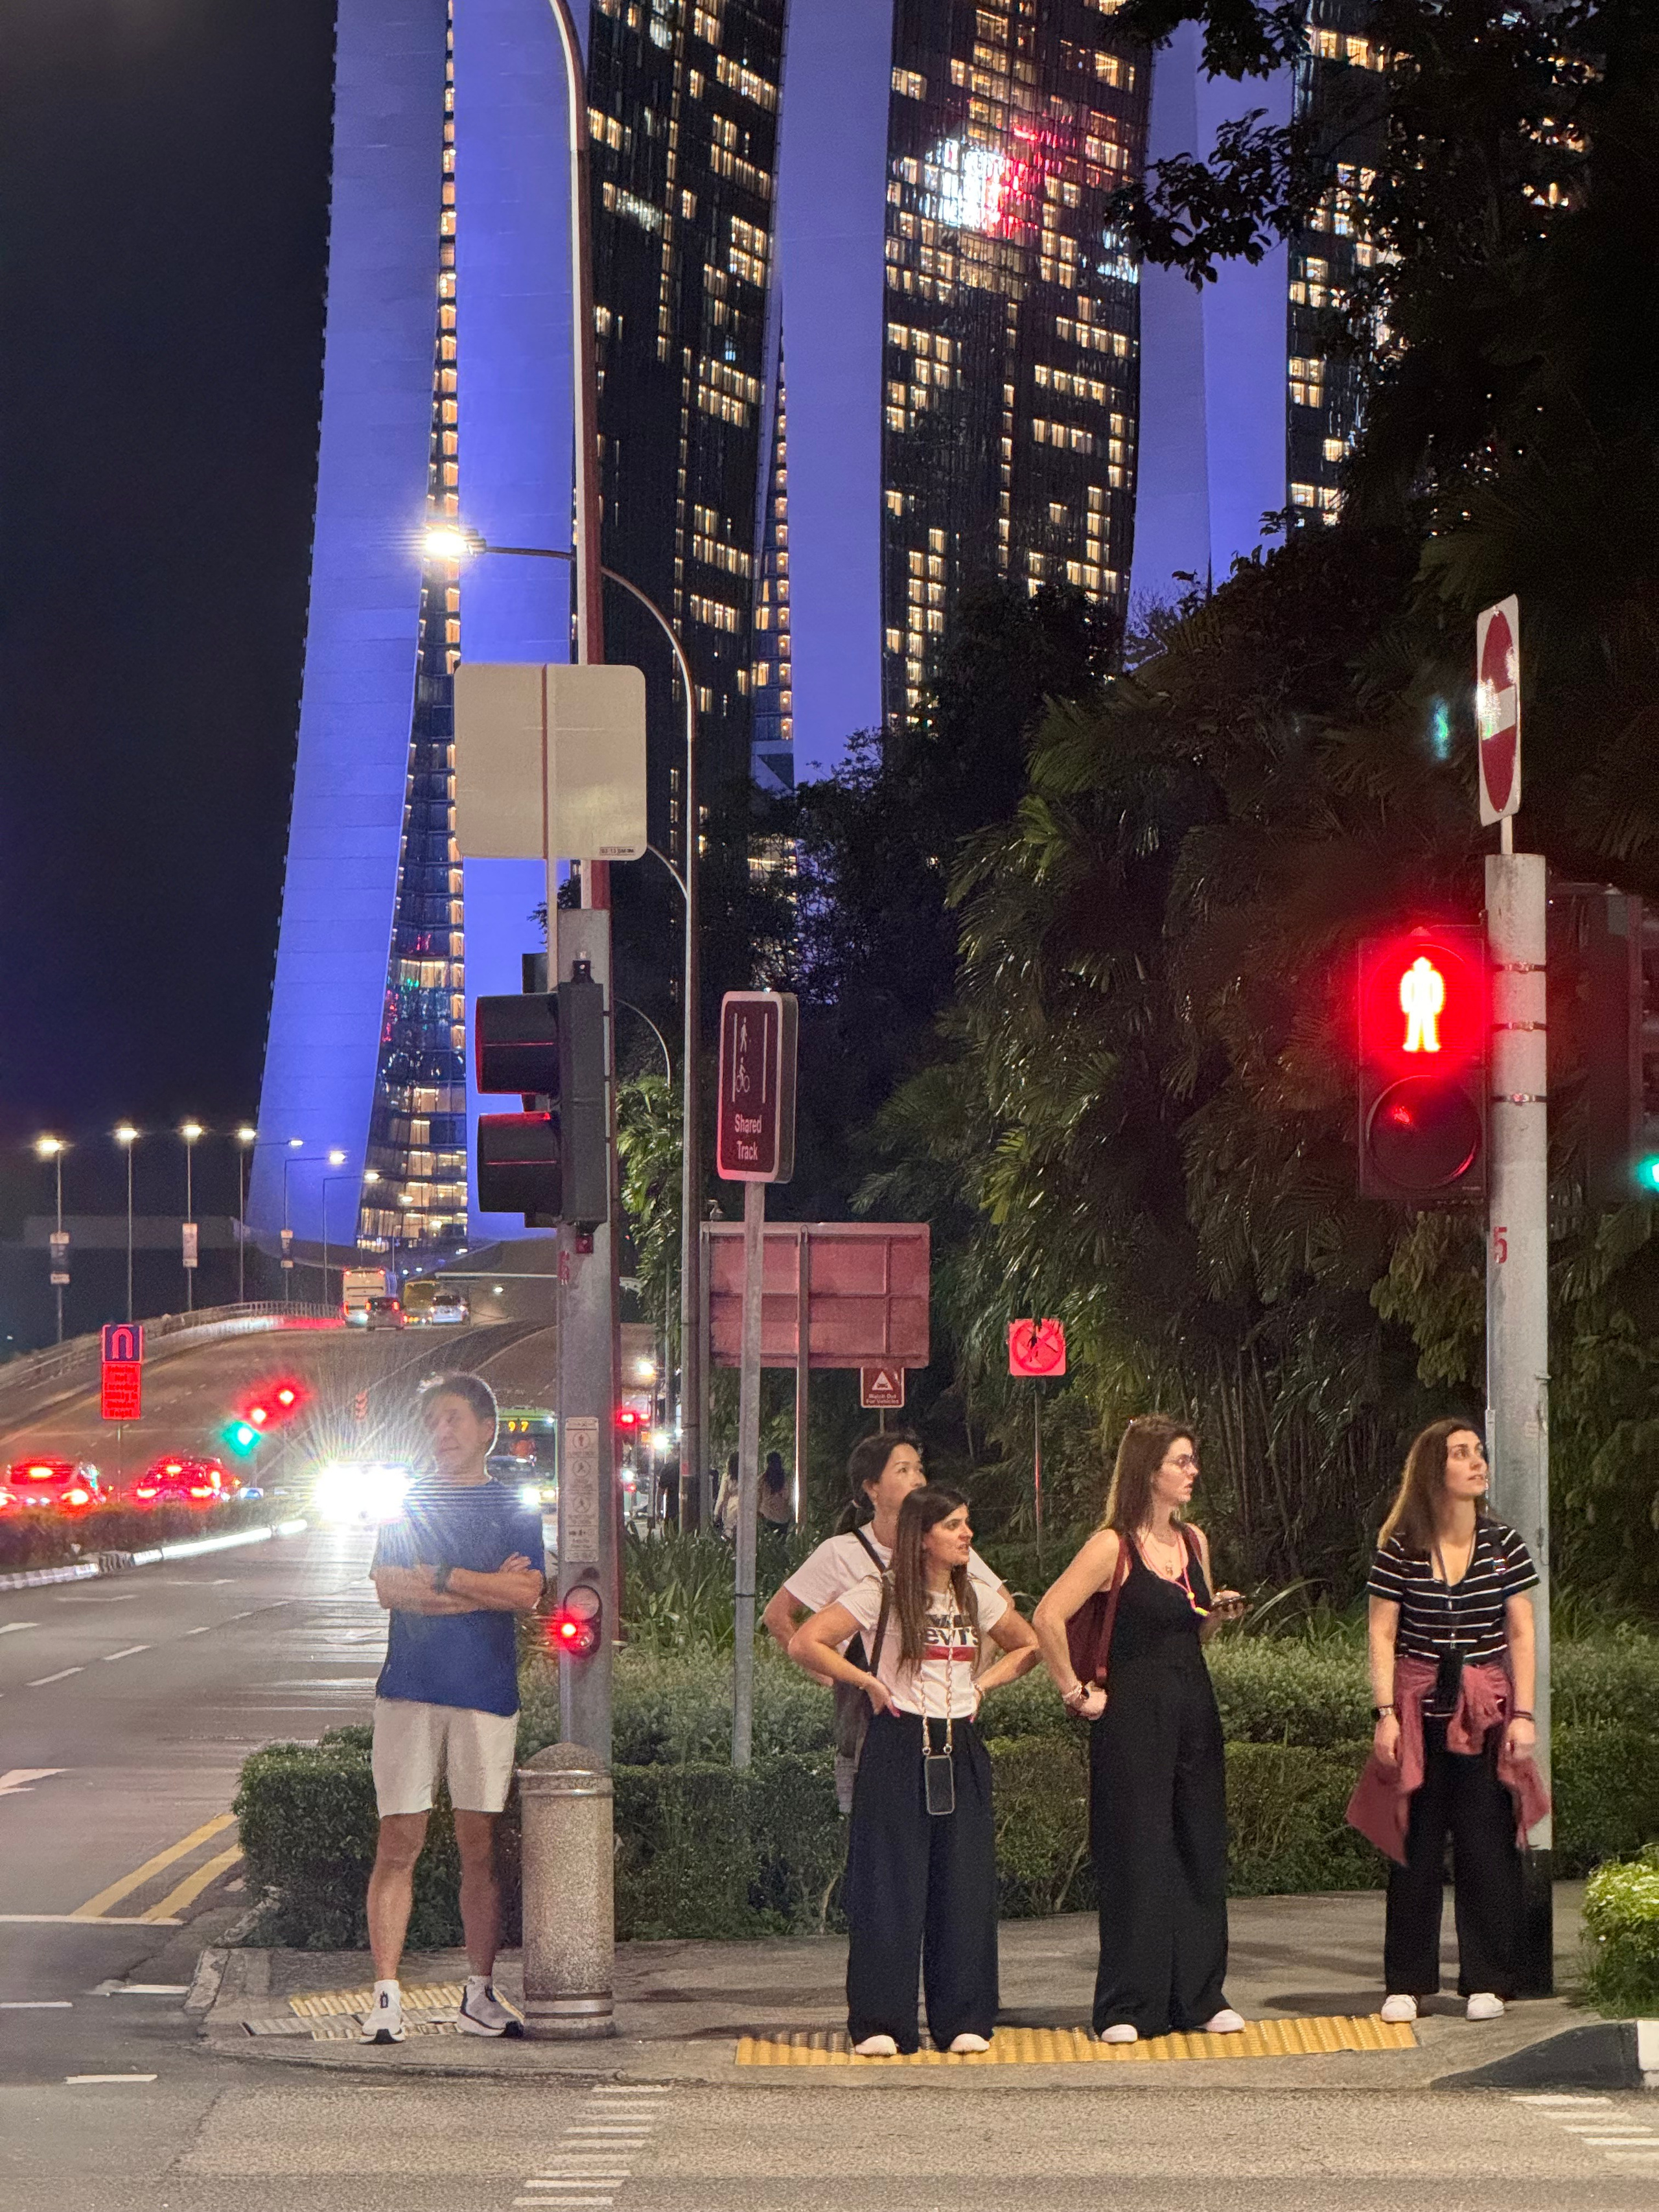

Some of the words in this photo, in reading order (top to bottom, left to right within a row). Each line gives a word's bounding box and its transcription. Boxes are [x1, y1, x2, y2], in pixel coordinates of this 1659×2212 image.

[734, 1113, 762, 1134] Shared
[736, 1140, 758, 1161] Track
[1494, 1226, 1507, 1264] 5
